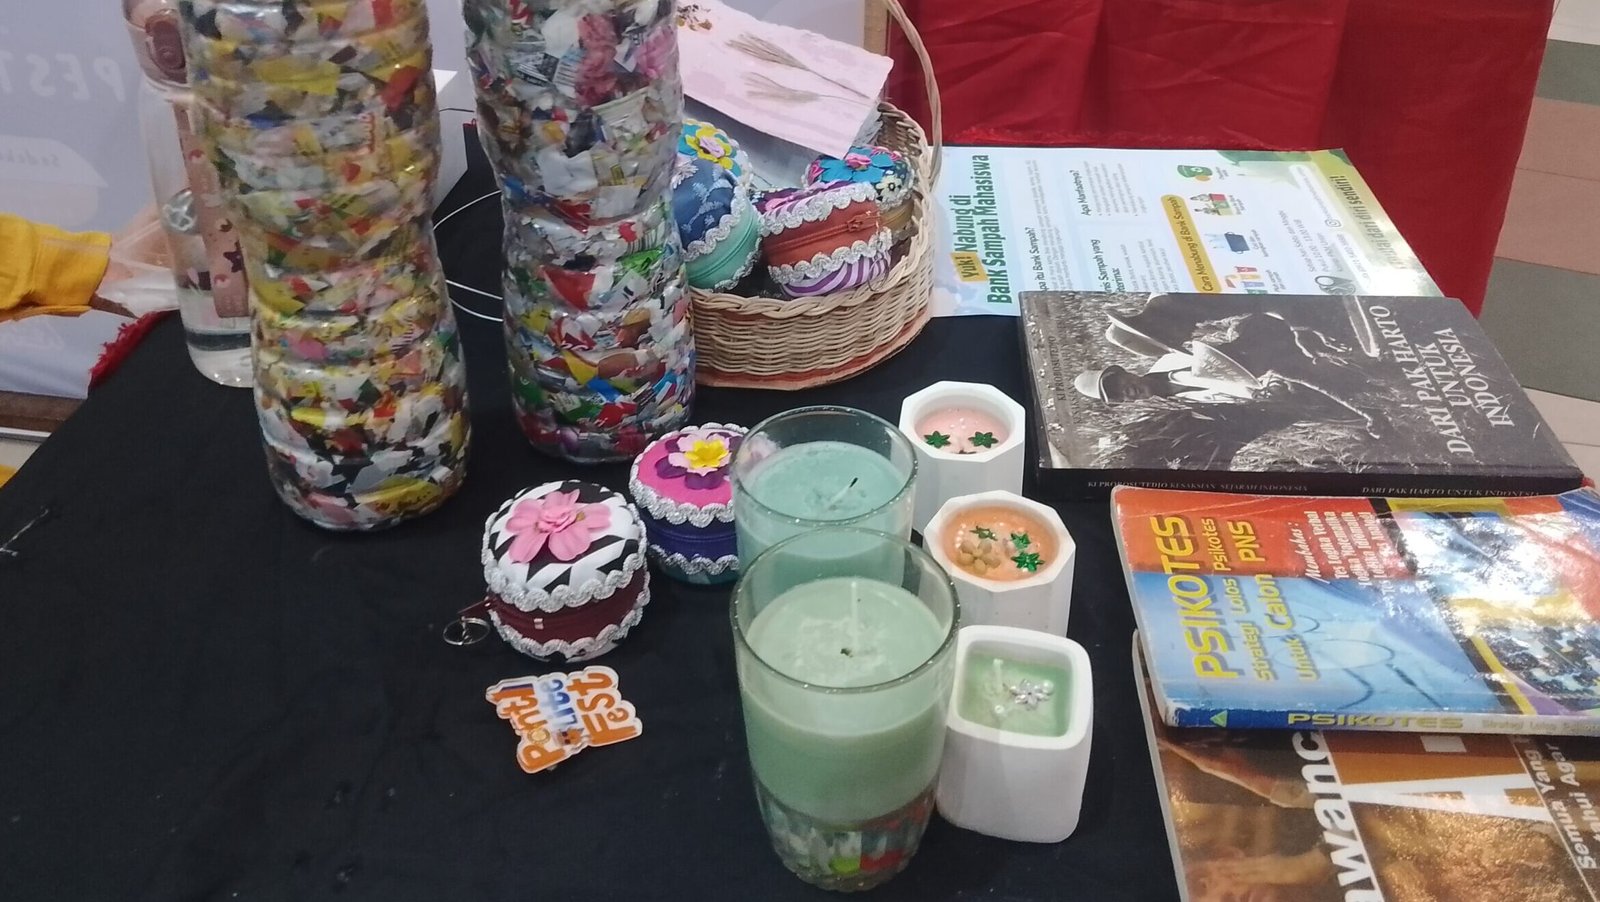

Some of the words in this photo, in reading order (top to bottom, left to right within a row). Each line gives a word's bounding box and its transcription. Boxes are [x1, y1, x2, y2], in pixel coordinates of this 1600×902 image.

[949, 195, 971, 206] di
[970, 155, 998, 216] Mahasiswa
[1329, 175, 1366, 205] sendiri!
[1081, 204, 1092, 216] Apa
[1168, 196, 1189, 221] Sampah
[950, 208, 978, 252] Nabung
[976, 219, 1006, 267] Sampah
[1025, 227, 1042, 255] Sampah?
[1178, 221, 1192, 236] Bank
[1365, 222, 1388, 239] dari
[1031, 255, 1043, 272] Bank
[1090, 239, 1104, 255] yang
[1187, 243, 1208, 275] Menabung
[955, 256, 979, 279] Yuk!
[1094, 255, 1110, 281] Sampah
[1199, 274, 1214, 291] Cara
[986, 269, 1012, 304] Bank
[1369, 305, 1419, 363] HARTO
[1402, 367, 1442, 402] PAK
[1415, 343, 1473, 407] UNTUK
[1434, 328, 1515, 428] INDONESIA
[1425, 406, 1474, 455] DARI
[1362, 486, 1386, 494] DARI
[1388, 487, 1407, 495] PAK
[1409, 487, 1445, 495] HARTO
[1447, 488, 1482, 496] UNTUK
[1303, 511, 1327, 536] Verbal
[1201, 518, 1232, 572] Psikotes
[1226, 520, 1266, 563] PNS
[1289, 528, 1331, 585] Membahas
[1319, 537, 1342, 564] Logika
[1333, 566, 1350, 579] Tes
[1348, 558, 1373, 586] Logika
[1363, 551, 1388, 578] Logika
[1149, 514, 1241, 680] PSIKOTES
[1223, 577, 1250, 616] Lolos
[1255, 573, 1296, 631] Calon
[1236, 620, 1277, 682] Strategi
[1281, 633, 1318, 682] Untuk
[565, 672, 637, 745] Fest
[1287, 712, 1465, 729] PSIKOTES
[1525, 750, 1555, 795] Yang
[1546, 742, 1580, 788] Agar
[1551, 800, 1597, 869] Semua
